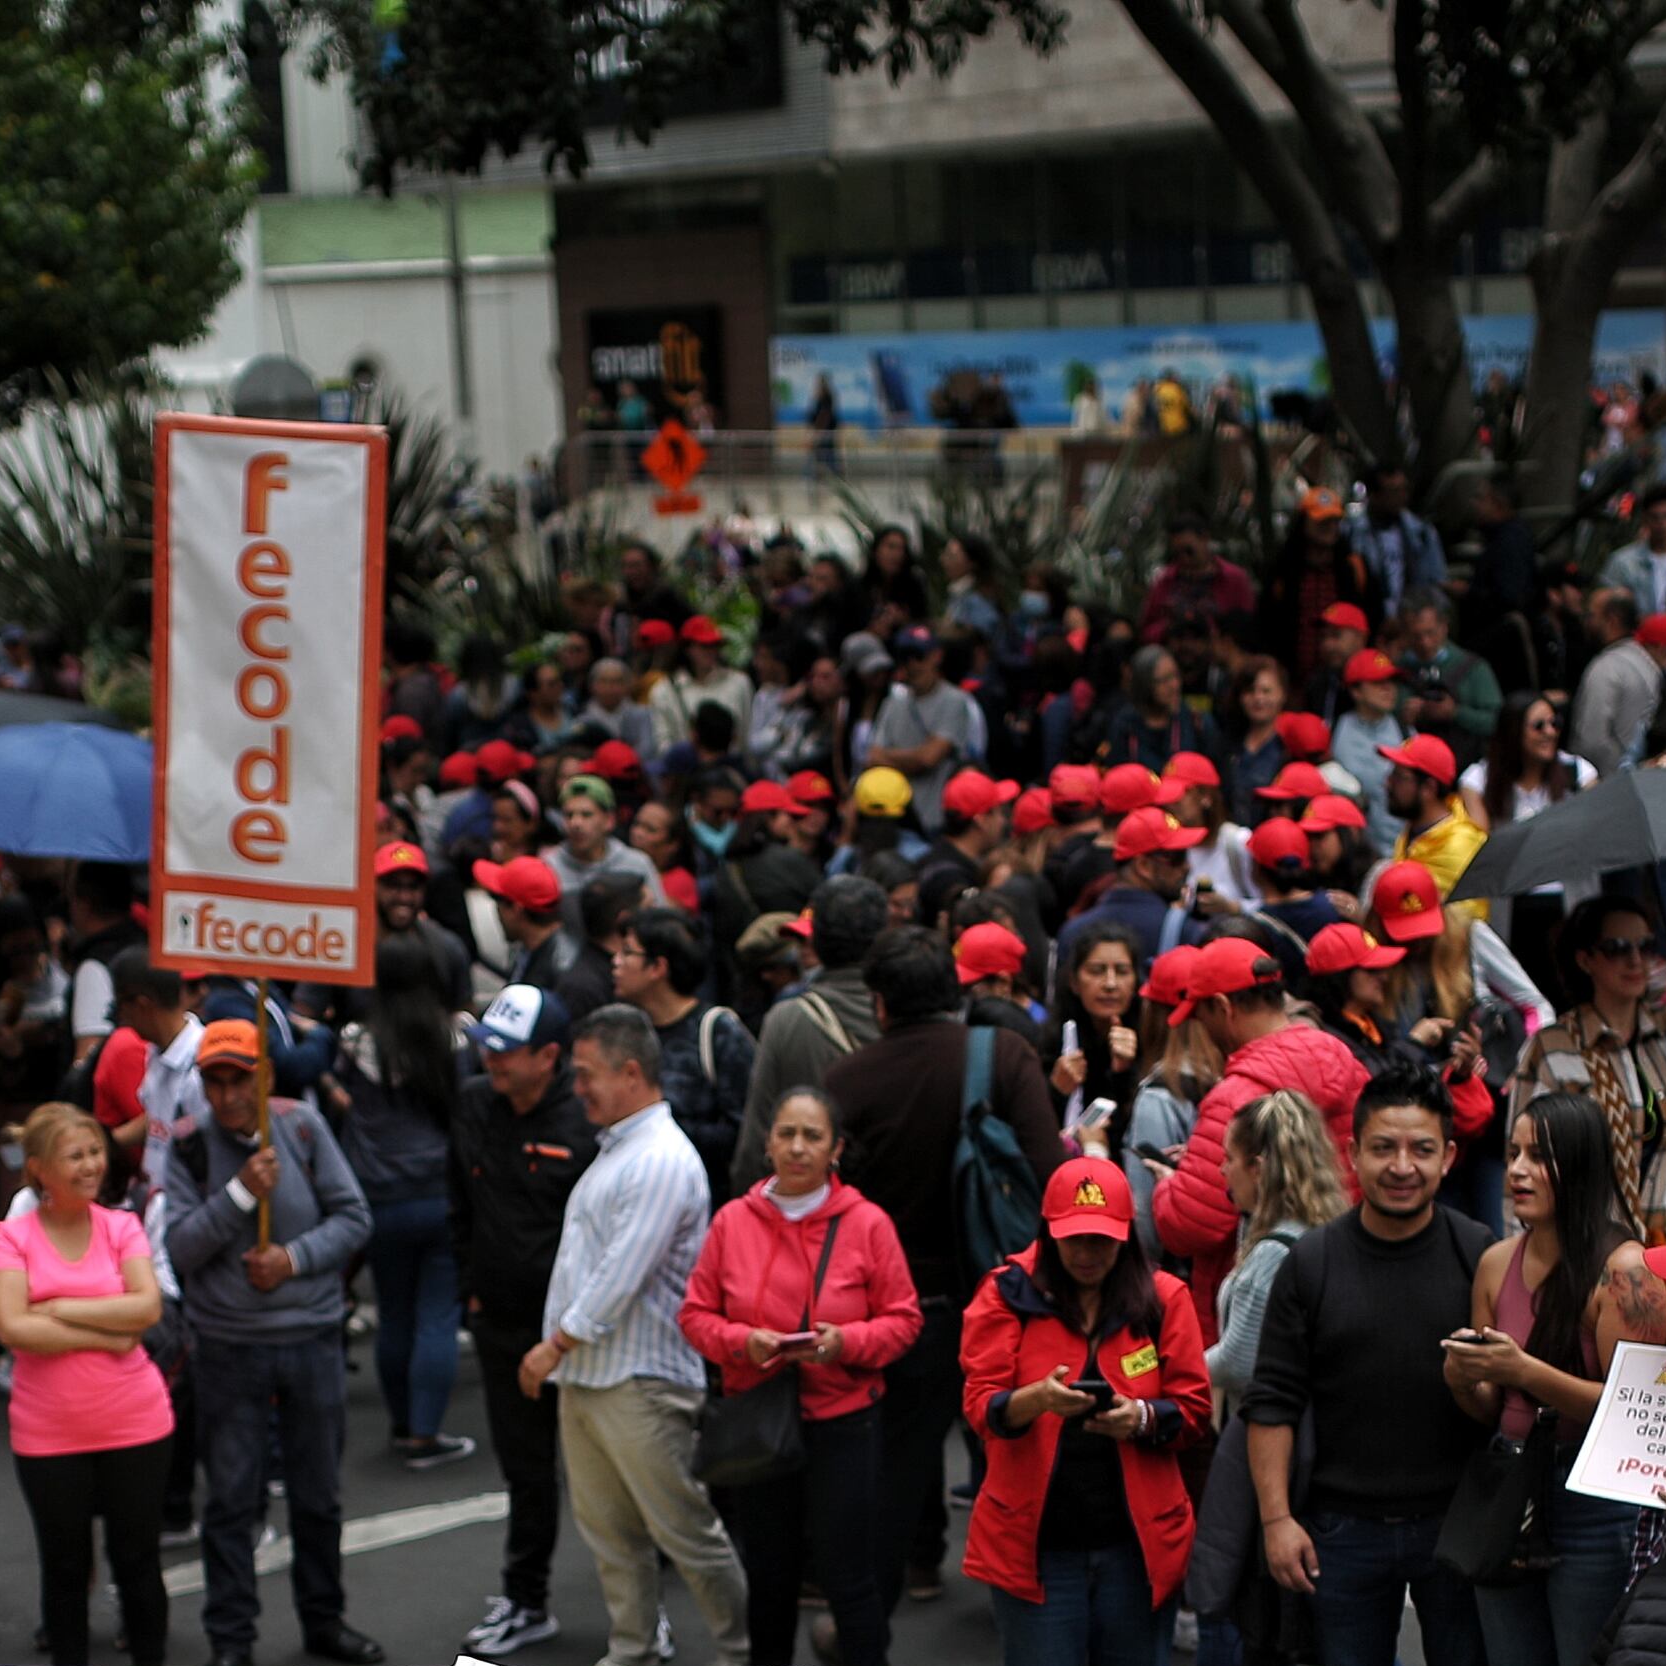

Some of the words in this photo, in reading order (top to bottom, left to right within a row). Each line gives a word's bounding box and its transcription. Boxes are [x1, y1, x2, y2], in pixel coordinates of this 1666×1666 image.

[228, 451, 293, 864] fecode
[194, 902, 345, 961] fecode
[1618, 1388, 1635, 1403] Si
[1637, 1390, 1653, 1405] la
[1626, 1406, 1649, 1421] no
[1636, 1422, 1664, 1439] del
